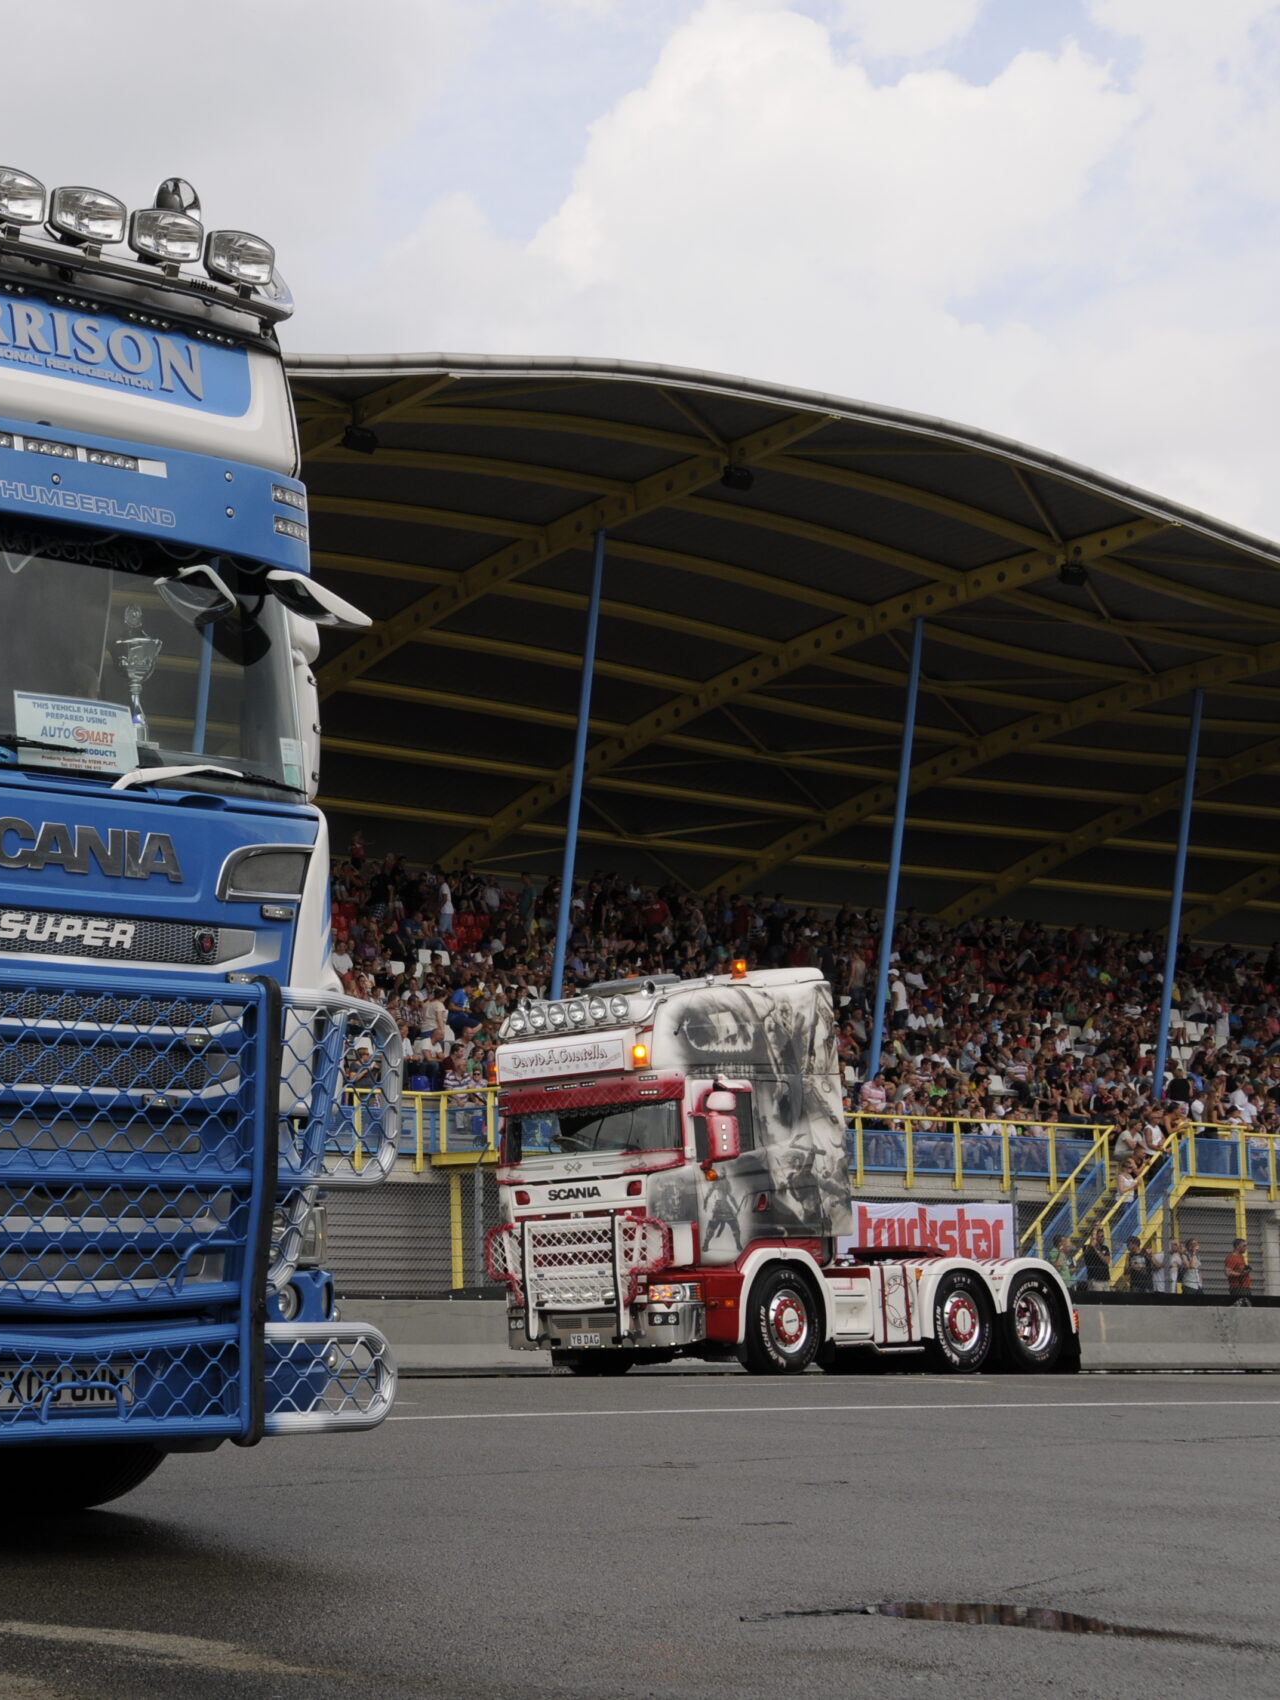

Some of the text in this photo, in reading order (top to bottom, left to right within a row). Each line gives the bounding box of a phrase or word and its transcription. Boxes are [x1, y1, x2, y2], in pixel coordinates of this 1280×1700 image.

[45, 357, 154, 391] REFRIGERATION
[32, 701, 117, 718] THIS VEHICLE HAS BEEN
[45, 712, 107, 725] PREPARED USING
[548, 1186, 601, 1201] SCANIA
[858, 1206, 1004, 1259] truckstar
[760, 1305, 778, 1360] MICHELIN
[936, 1305, 952, 1357] MICHELIN
